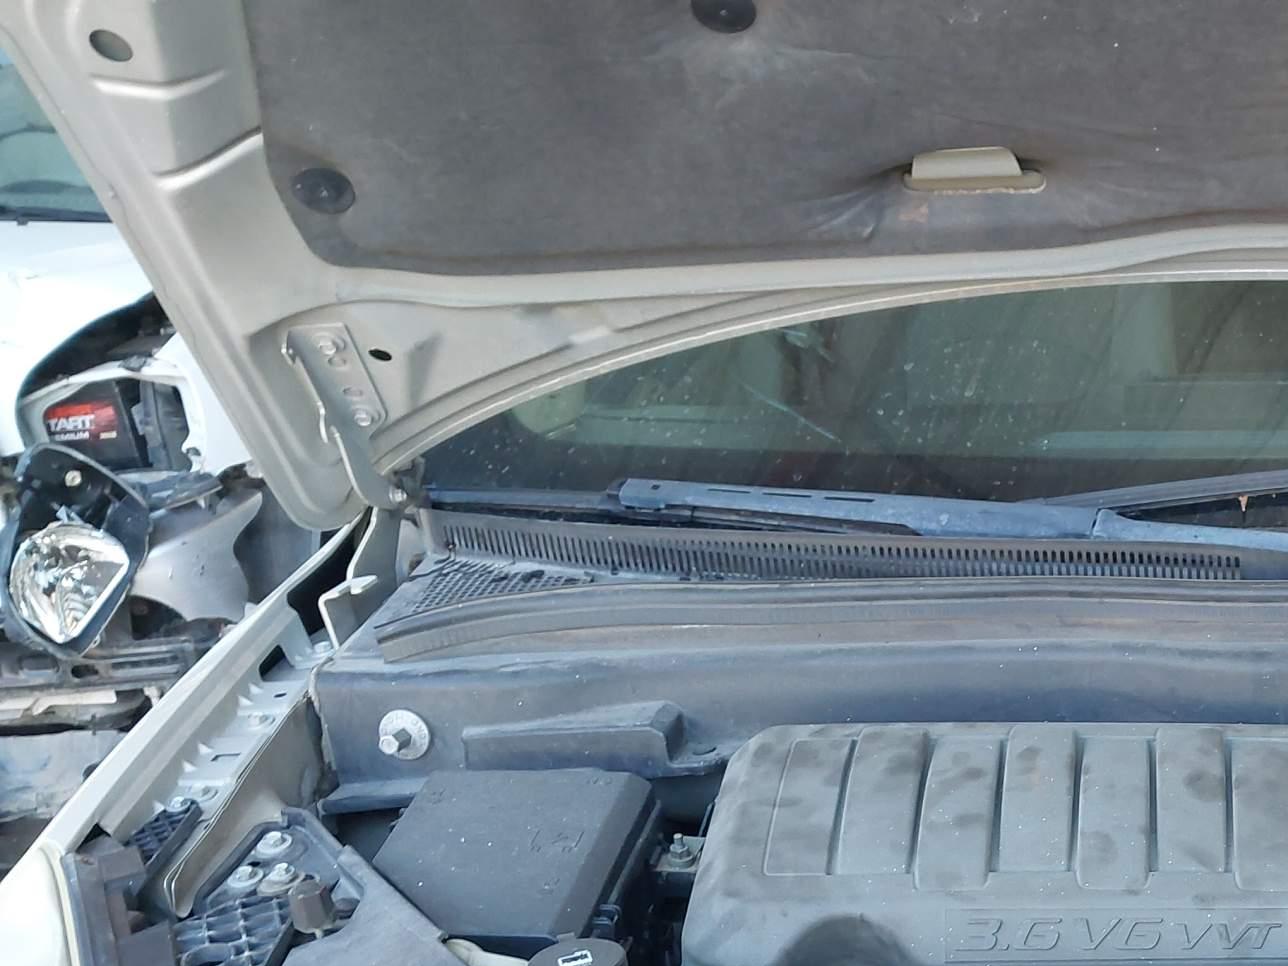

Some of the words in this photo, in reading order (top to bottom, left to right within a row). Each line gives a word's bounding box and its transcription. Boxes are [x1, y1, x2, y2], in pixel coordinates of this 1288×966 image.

[48, 414, 95, 431] TART
[954, 917, 1064, 952] 3.6
[1074, 917, 1164, 951] V6
[1178, 921, 1283, 951] VVT
